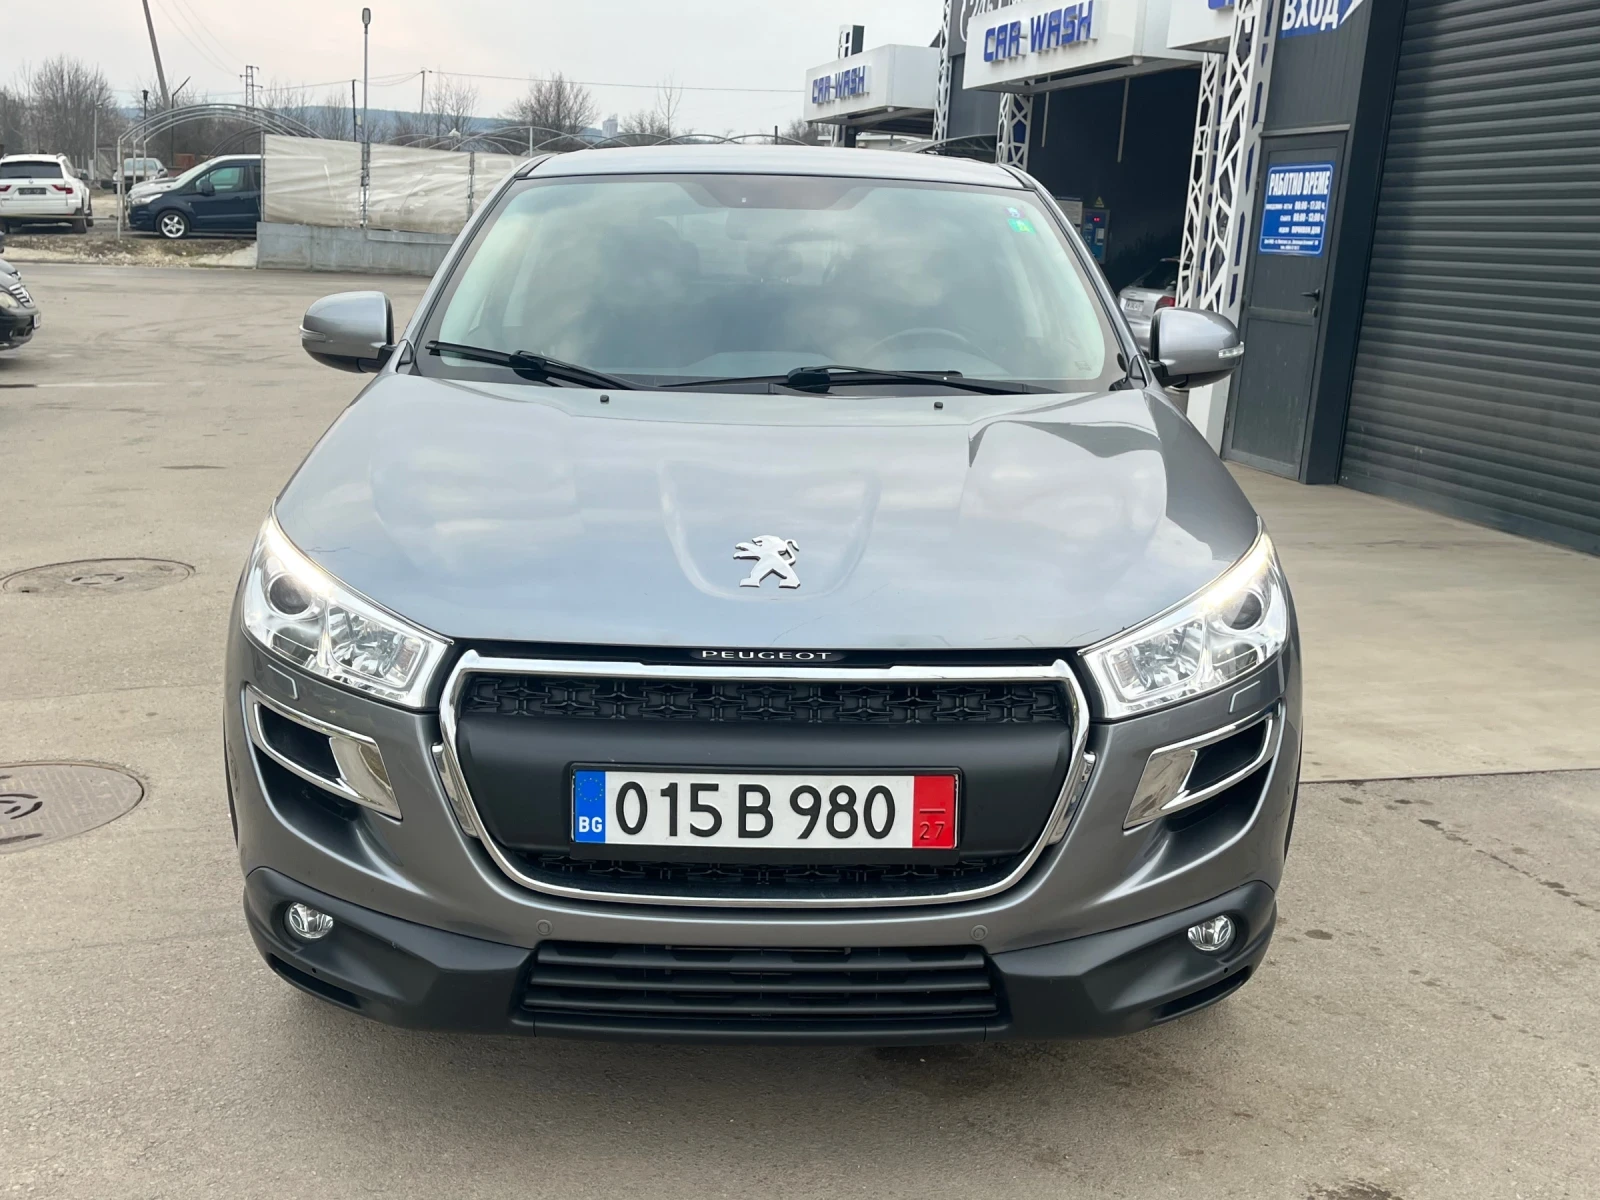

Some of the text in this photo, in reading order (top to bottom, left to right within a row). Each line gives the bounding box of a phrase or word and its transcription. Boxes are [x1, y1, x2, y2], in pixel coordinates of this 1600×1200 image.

[984, 20, 1022, 63] CAR
[1030, 0, 1094, 53] WASH
[812, 65, 866, 104] CAR WASH
[1268, 171, 1331, 196] РАБОТНО ВРЕМЕ
[702, 650, 832, 660] PEUGEOT
[578, 816, 603, 833] BG
[919, 821, 946, 841] 27
